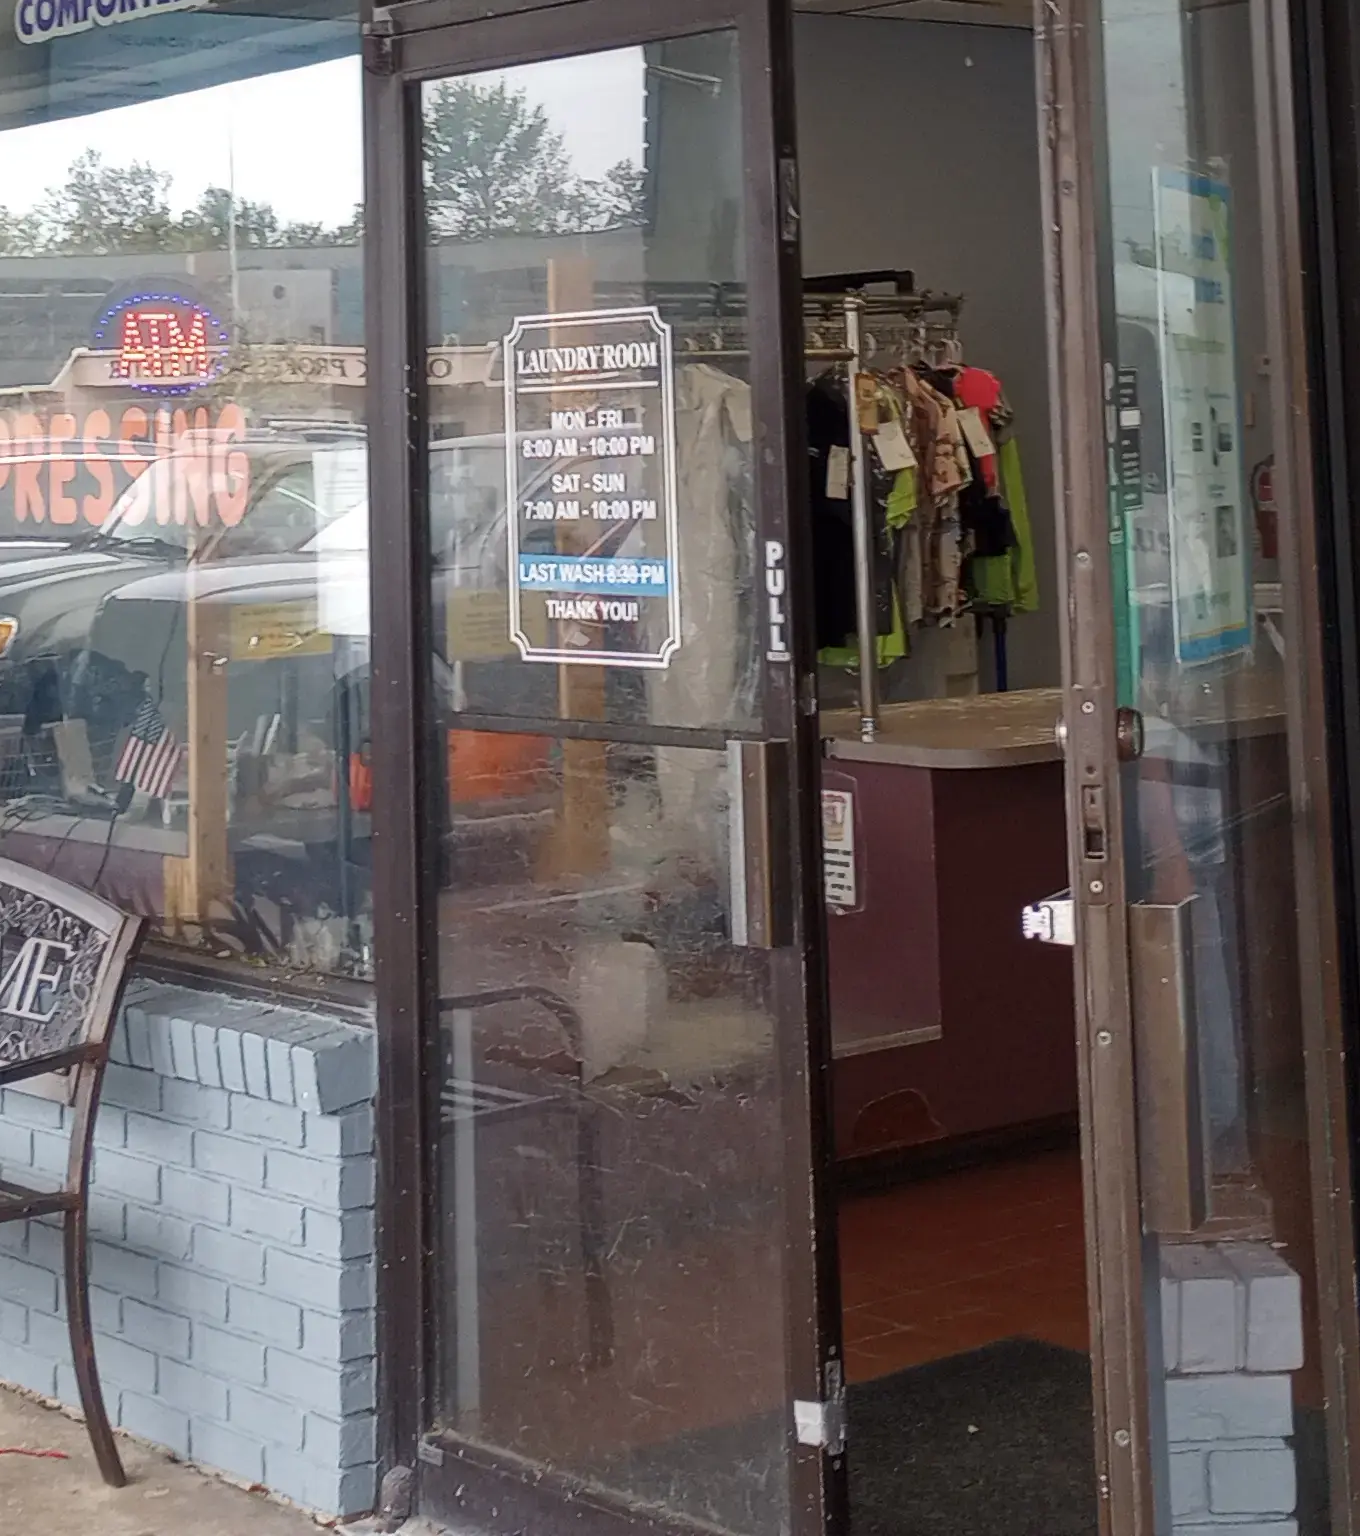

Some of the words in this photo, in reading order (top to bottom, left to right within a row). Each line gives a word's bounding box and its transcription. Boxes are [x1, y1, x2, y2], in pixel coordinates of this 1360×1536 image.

[121, 312, 208, 378] ATM
[516, 345, 601, 373] LAUNDRY
[603, 342, 658, 369] ROOM
[551, 412, 586, 430] MON
[597, 410, 623, 428] FRI
[554, 438, 578, 456] AM
[589, 437, 628, 455] 10:00
[630, 436, 654, 454] PM
[552, 474, 580, 492] SAT
[592, 473, 625, 492] SUN
[555, 501, 579, 519] AM
[590, 501, 629, 519] 10:00
[632, 500, 656, 519] PM
[520, 564, 557, 582] LAST
[559, 565, 604, 583] WASH
[641, 565, 665, 584] PM
[766, 540, 786, 651] PULL
[545, 600, 599, 621] THANK
[598, 602, 639, 621] YOU!
